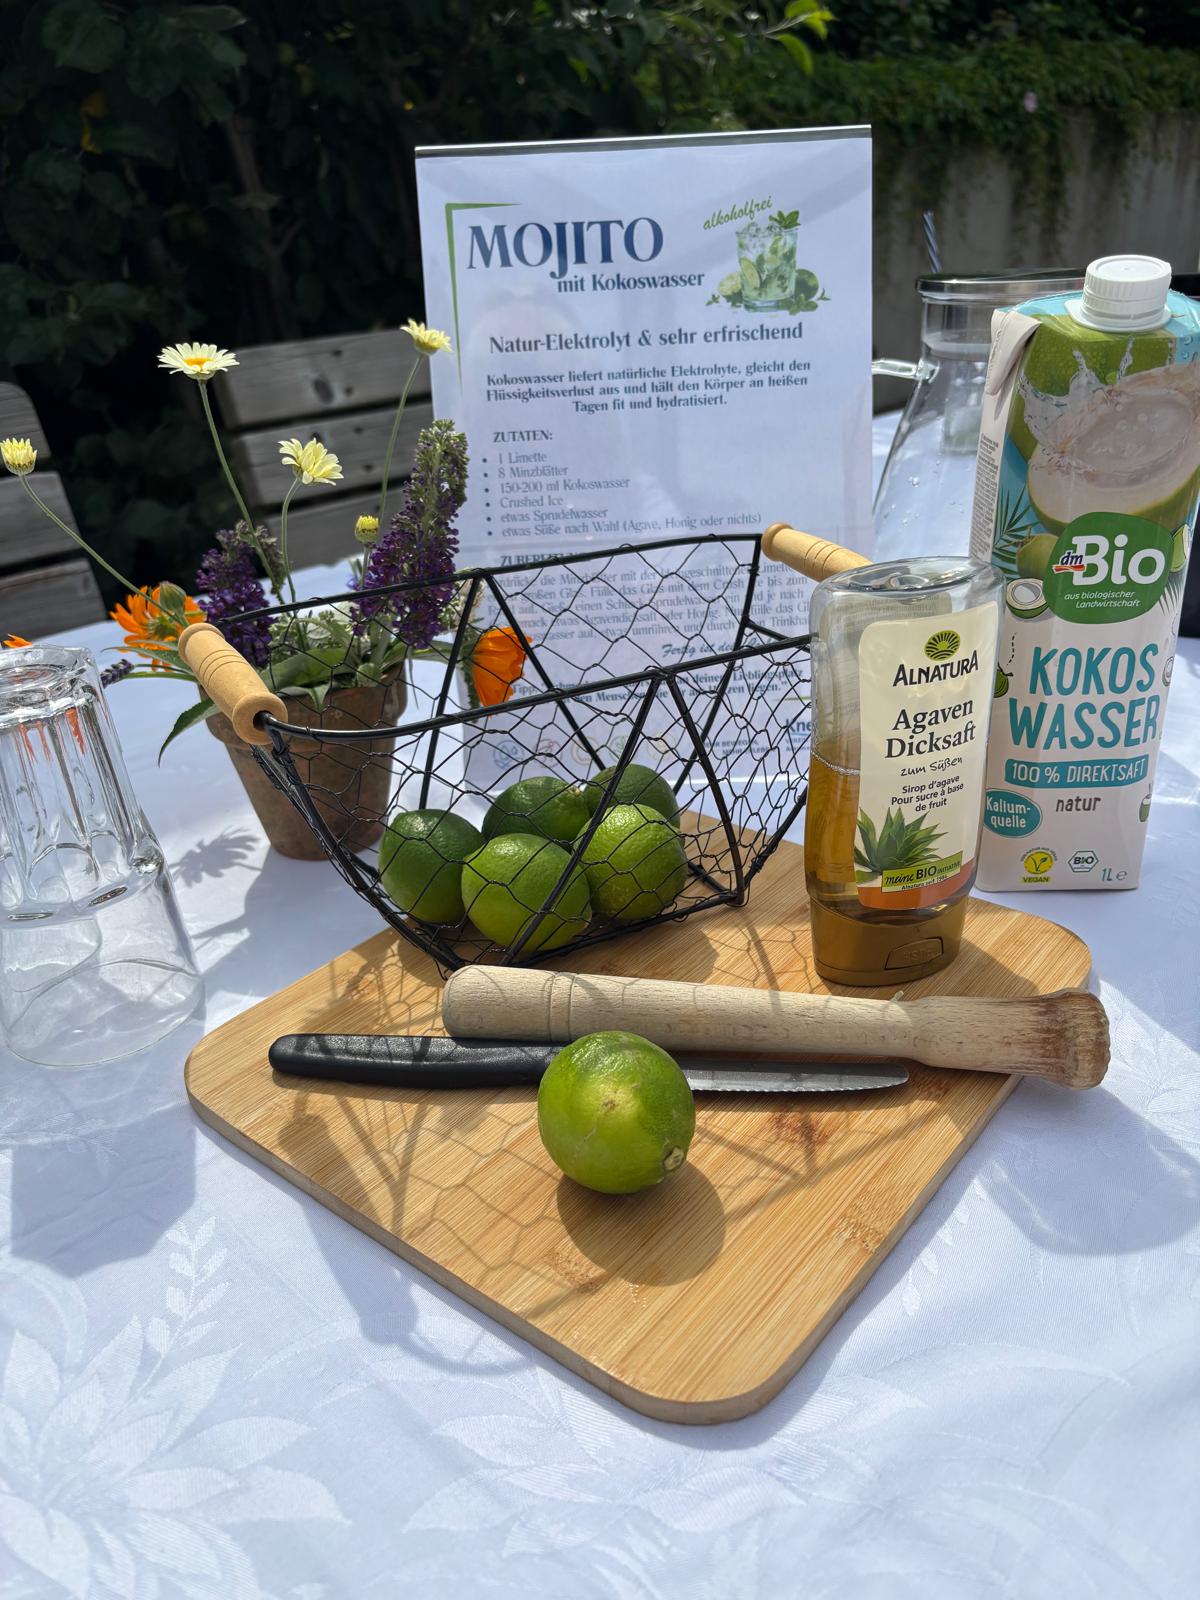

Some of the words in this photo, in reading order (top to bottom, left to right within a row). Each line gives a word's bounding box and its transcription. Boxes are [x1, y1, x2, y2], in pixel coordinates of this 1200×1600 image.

[703, 195, 773, 231] alkoholfrei
[467, 217, 664, 279] MOJITO
[557, 277, 585, 293] mit
[591, 271, 705, 292] Kokoswasser
[489, 331, 631, 354] Natur-Elektrolyt
[638, 329, 651, 347] &
[659, 328, 697, 346] sehr
[703, 322, 803, 344] erfrischend
[486, 374, 564, 386] Kokoswasser
[568, 371, 603, 382] liefert
[607, 367, 667, 381] natürliche
[745, 360, 785, 375] gleicht
[789, 360, 811, 371] den
[486, 386, 595, 403] Flüssigkeitsverlust
[599, 387, 620, 396] aus
[624, 382, 646, 394] und
[651, 381, 673, 393] hält
[678, 380, 699, 392] den
[704, 378, 746, 392] Körper
[749, 379, 764, 388] an
[768, 375, 808, 387] heißen
[572, 400, 608, 415] Tagen
[612, 399, 625, 410] fit
[630, 397, 652, 409] und
[656, 394, 727, 411] hydratisiert.
[493, 430, 553, 443] ZUTATEN:
[499, 453, 503, 464] 1
[508, 452, 548, 464] Limette
[498, 467, 506, 478] 8
[510, 465, 568, 478] Minzblätter
[500, 482, 543, 494] 150-200
[546, 480, 560, 491] ml
[563, 478, 630, 491] Kokoswasser
[500, 496, 544, 508] Crushed
[548, 496, 564, 506] Ice
[501, 511, 530, 522] etwas
[533, 508, 608, 523] Sprudelwasser
[502, 526, 531, 537] etwas
[534, 523, 560, 536] Süße
[565, 522, 589, 534] nach
[592, 520, 619, 532] Wahl
[665, 517, 697, 530] Honig
[700, 515, 723, 526] oder
[727, 513, 761, 525] nichts)
[1061, 551, 1084, 566] dm
[1072, 534, 1166, 586] Bio
[767, 576, 783, 587] bis
[786, 576, 808, 586] zum
[780, 588, 804, 600] nach
[1081, 590, 1135, 601] biologischer
[775, 602, 794, 613] das
[1076, 599, 1141, 609] Landwirtschaft
[892, 650, 978, 687] ALNATURA
[1029, 643, 1159, 696] KOKOS
[892, 700, 973, 734] Agaven
[1008, 694, 1160, 750] WASSER
[884, 720, 976, 759] Dicksaft
[900, 767, 926, 777] zum
[929, 757, 963, 772] Süßen
[1012, 763, 1040, 783] 100
[1045, 766, 1060, 784] %
[1066, 759, 1147, 783] DIREKTSAFT
[891, 795, 913, 806] Pour
[916, 791, 938, 803] sucre
[940, 788, 945, 797] à
[947, 783, 964, 794] base
[902, 784, 926, 794] Sirop
[915, 803, 927, 812] de
[929, 798, 947, 810] fruit
[986, 796, 1031, 814] Kalium-
[1055, 796, 1102, 813] natur
[990, 814, 1027, 829] quelle
[1073, 856, 1095, 865] BIO
[885, 873, 914, 885] meine
[916, 865, 937, 880] BIO
